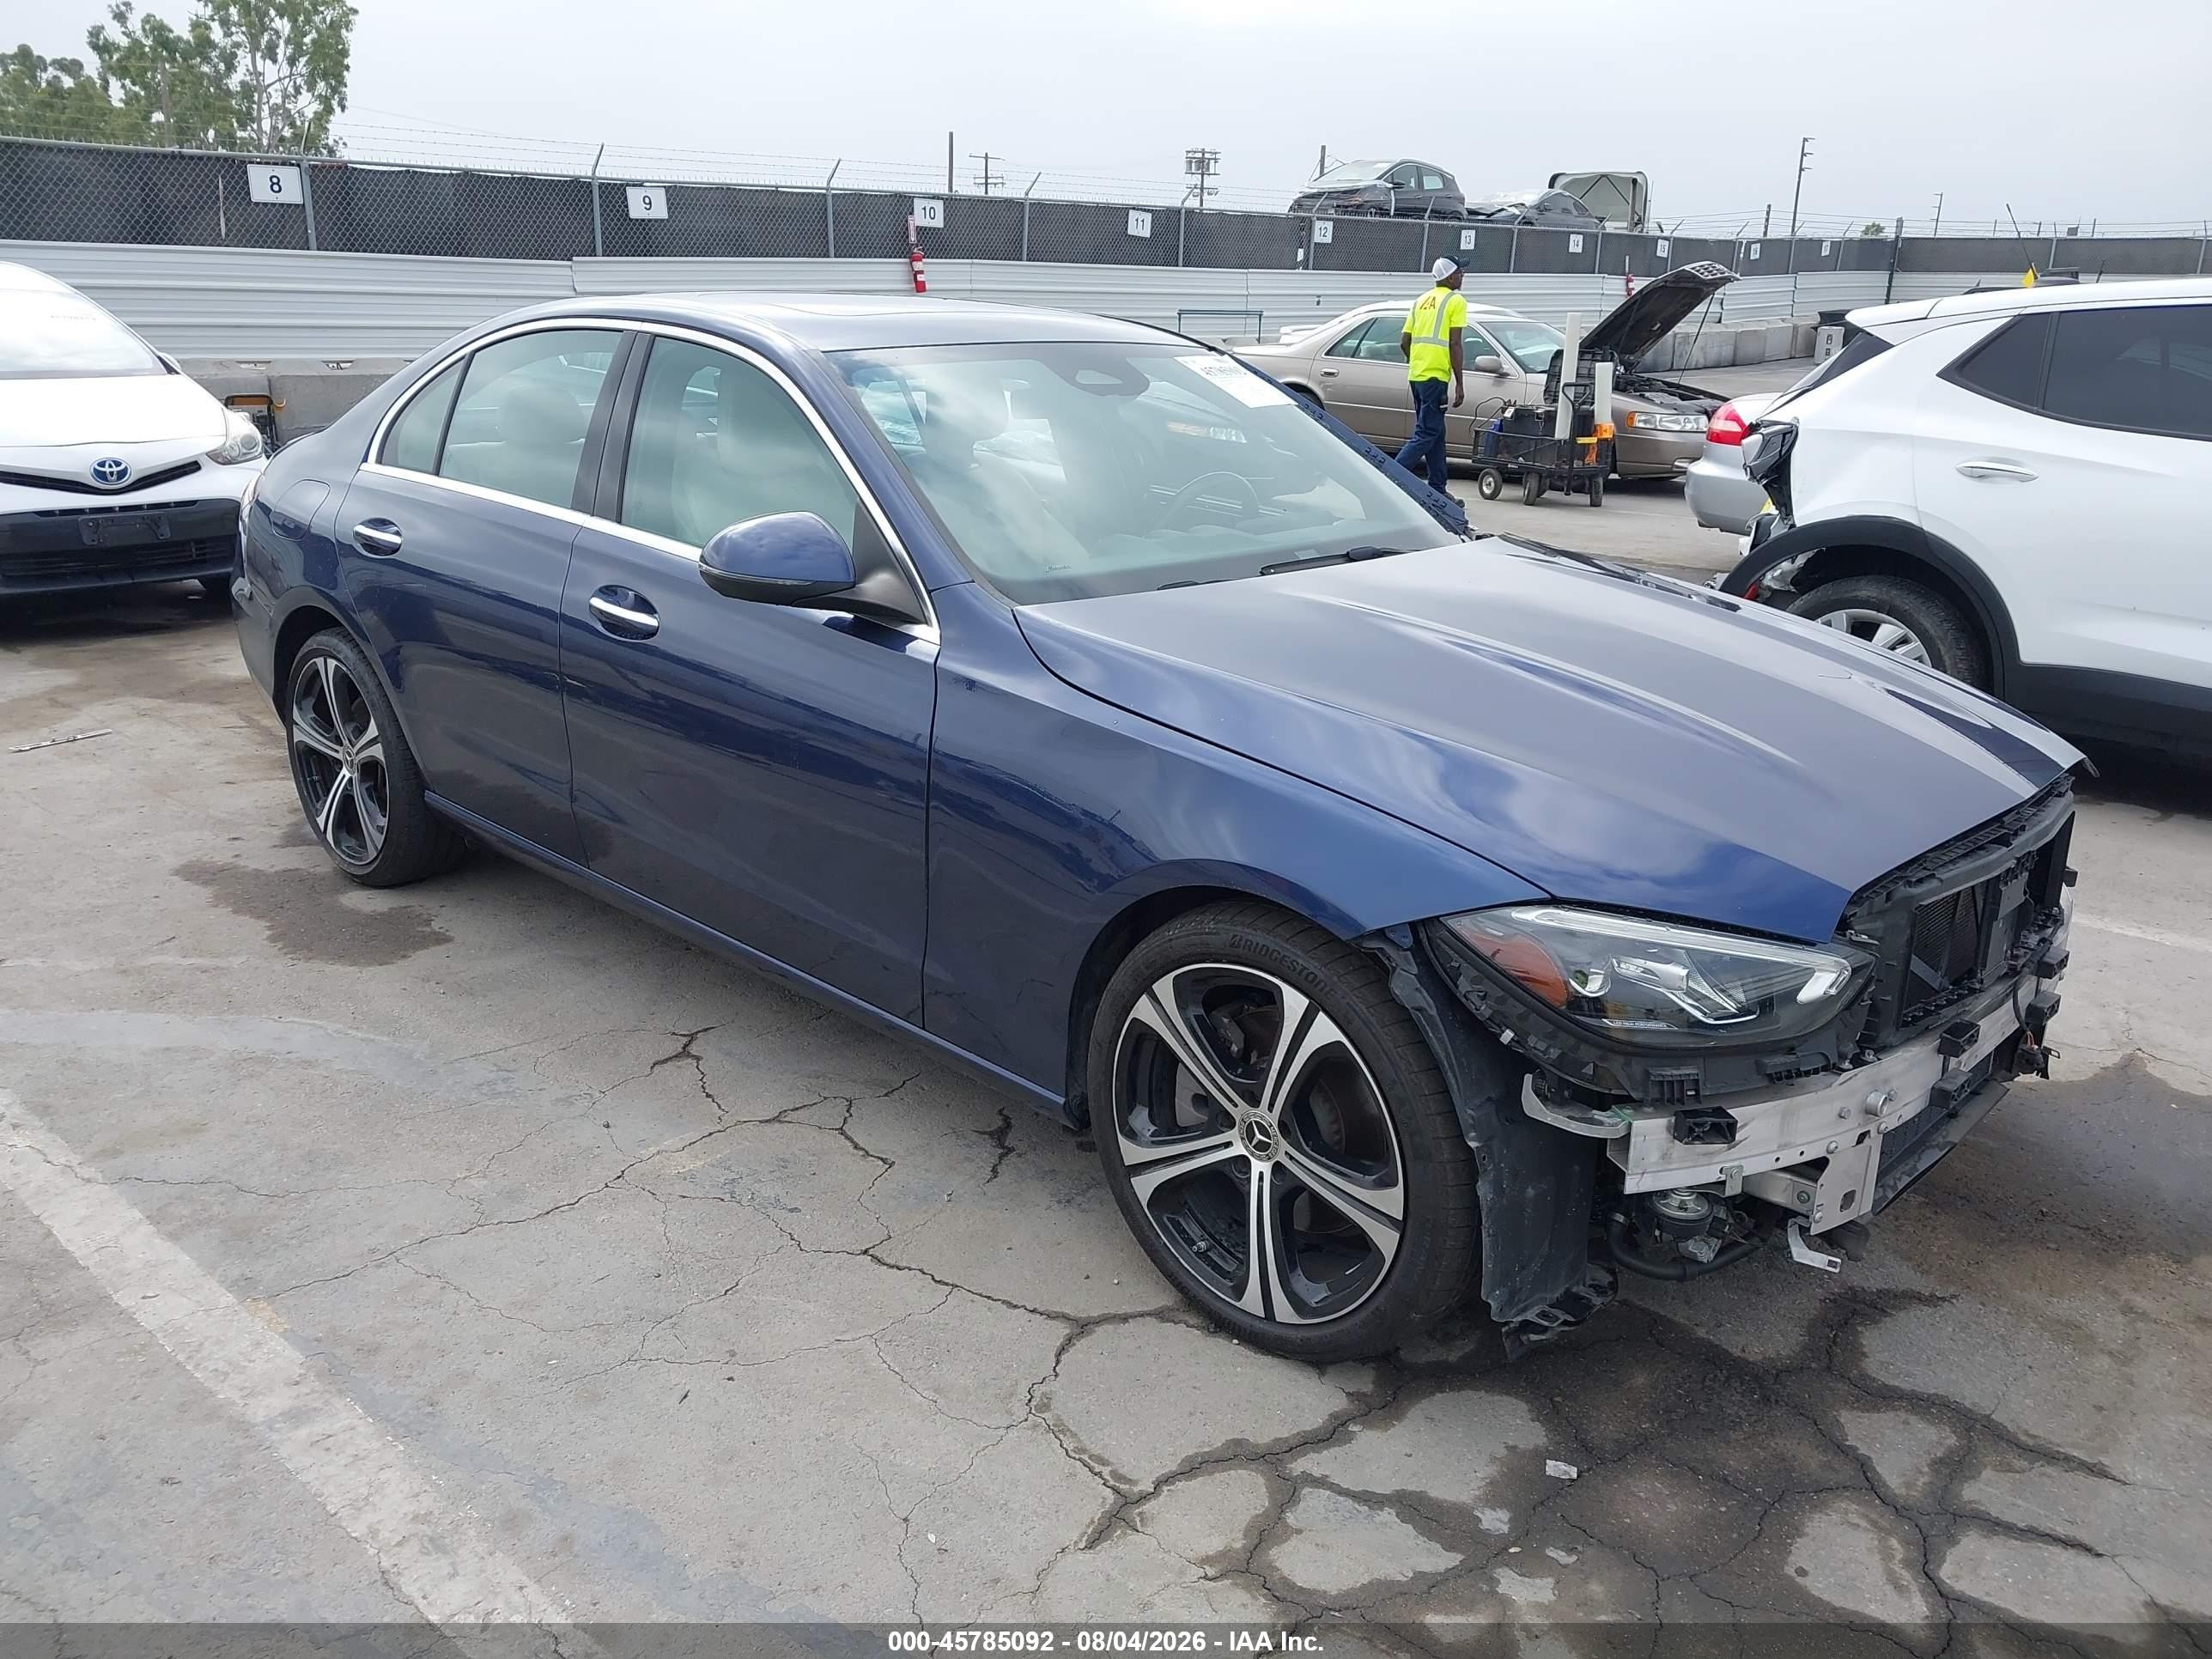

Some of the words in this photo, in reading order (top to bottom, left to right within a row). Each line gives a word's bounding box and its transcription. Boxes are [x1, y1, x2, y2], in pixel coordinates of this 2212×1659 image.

[269, 175, 282, 193] 8
[642, 195, 653, 211] 9
[921, 205, 936, 220] 10
[1134, 216, 1146, 230] 11
[1318, 226, 1328, 238] 12
[1464, 234, 1472, 245] 13
[1572, 239, 1580, 248] 14
[1660, 243, 1666, 253] 15
[1229, 933, 1339, 1000] BRIDGESTONE
